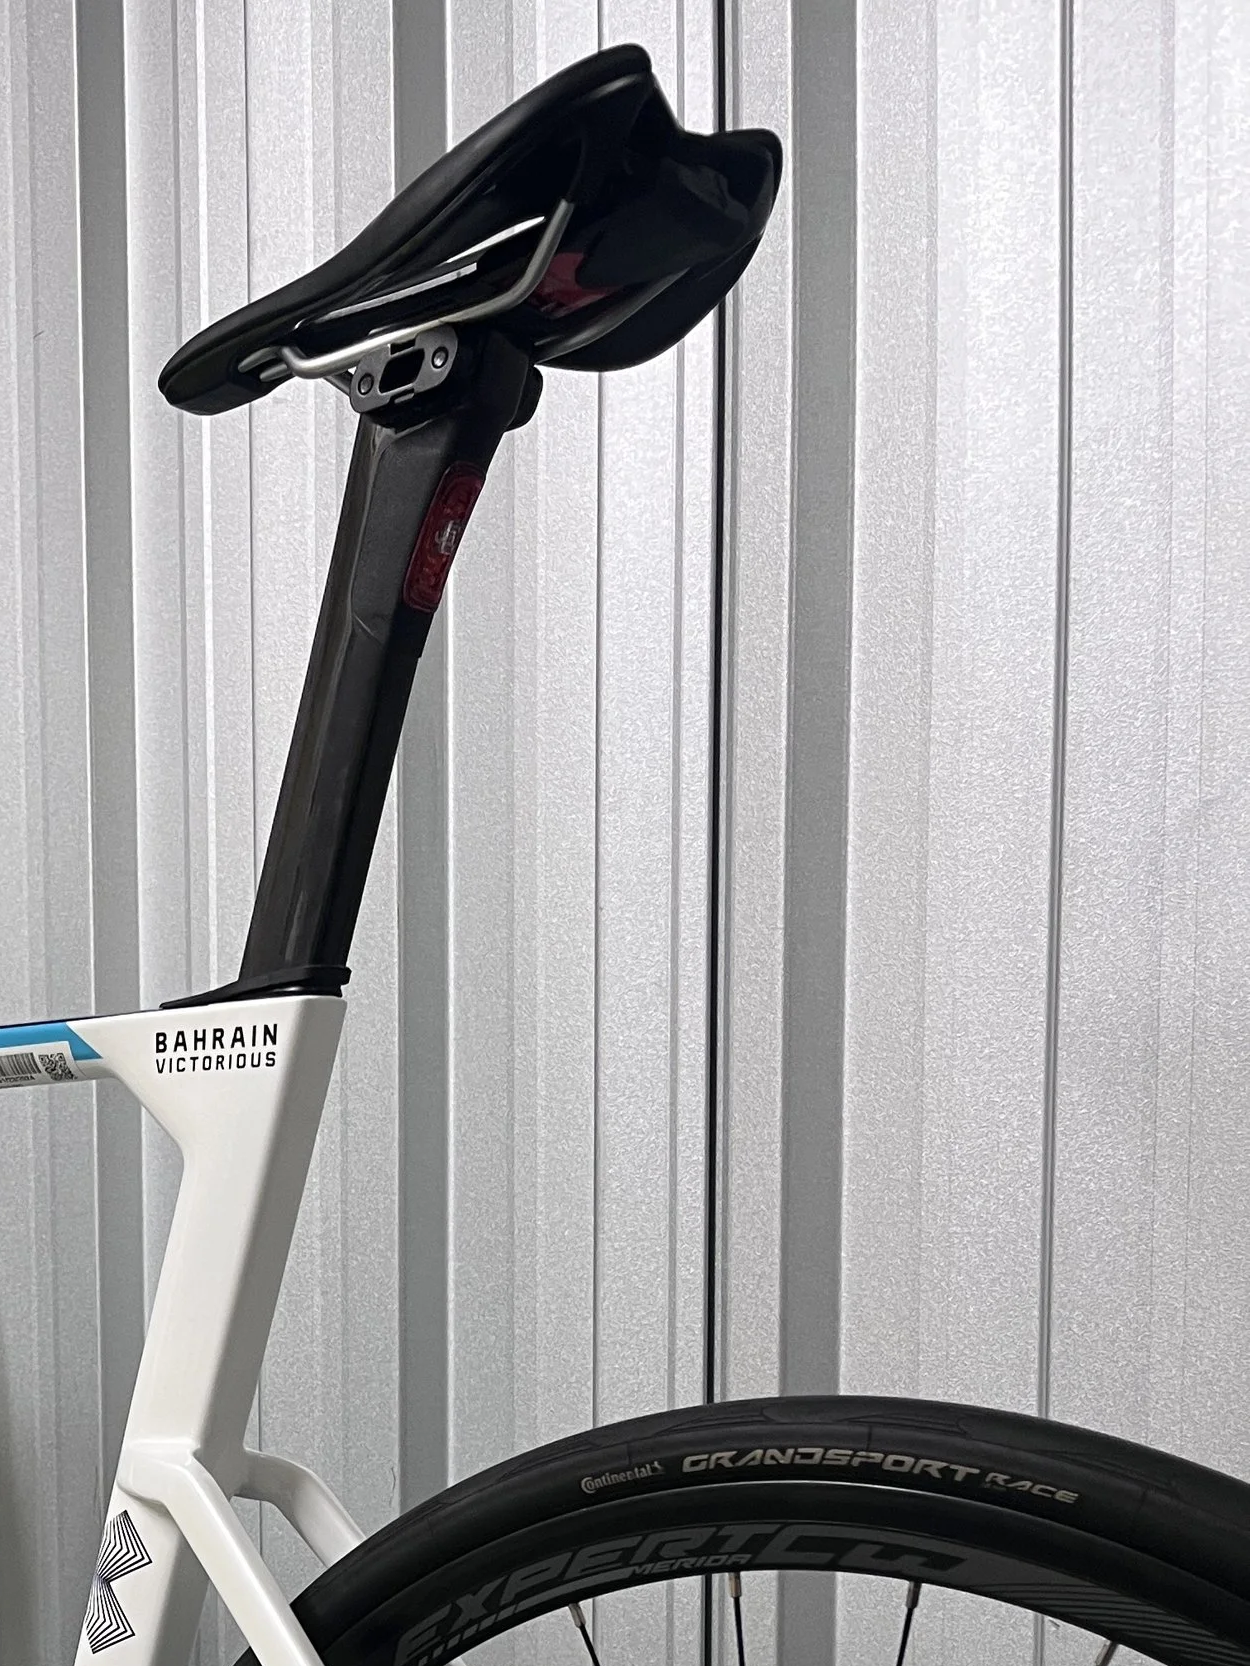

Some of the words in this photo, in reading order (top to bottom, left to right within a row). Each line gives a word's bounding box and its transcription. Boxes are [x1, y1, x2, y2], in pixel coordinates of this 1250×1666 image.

[155, 1023, 279, 1054] BAHRAIN
[155, 1051, 277, 1074] VICTORIOUS
[580, 1462, 653, 1494] Continental
[682, 1447, 980, 1482] GRANDSPORT
[984, 1472, 1080, 1504] RACE
[629, 1552, 752, 1577] MERIDA
